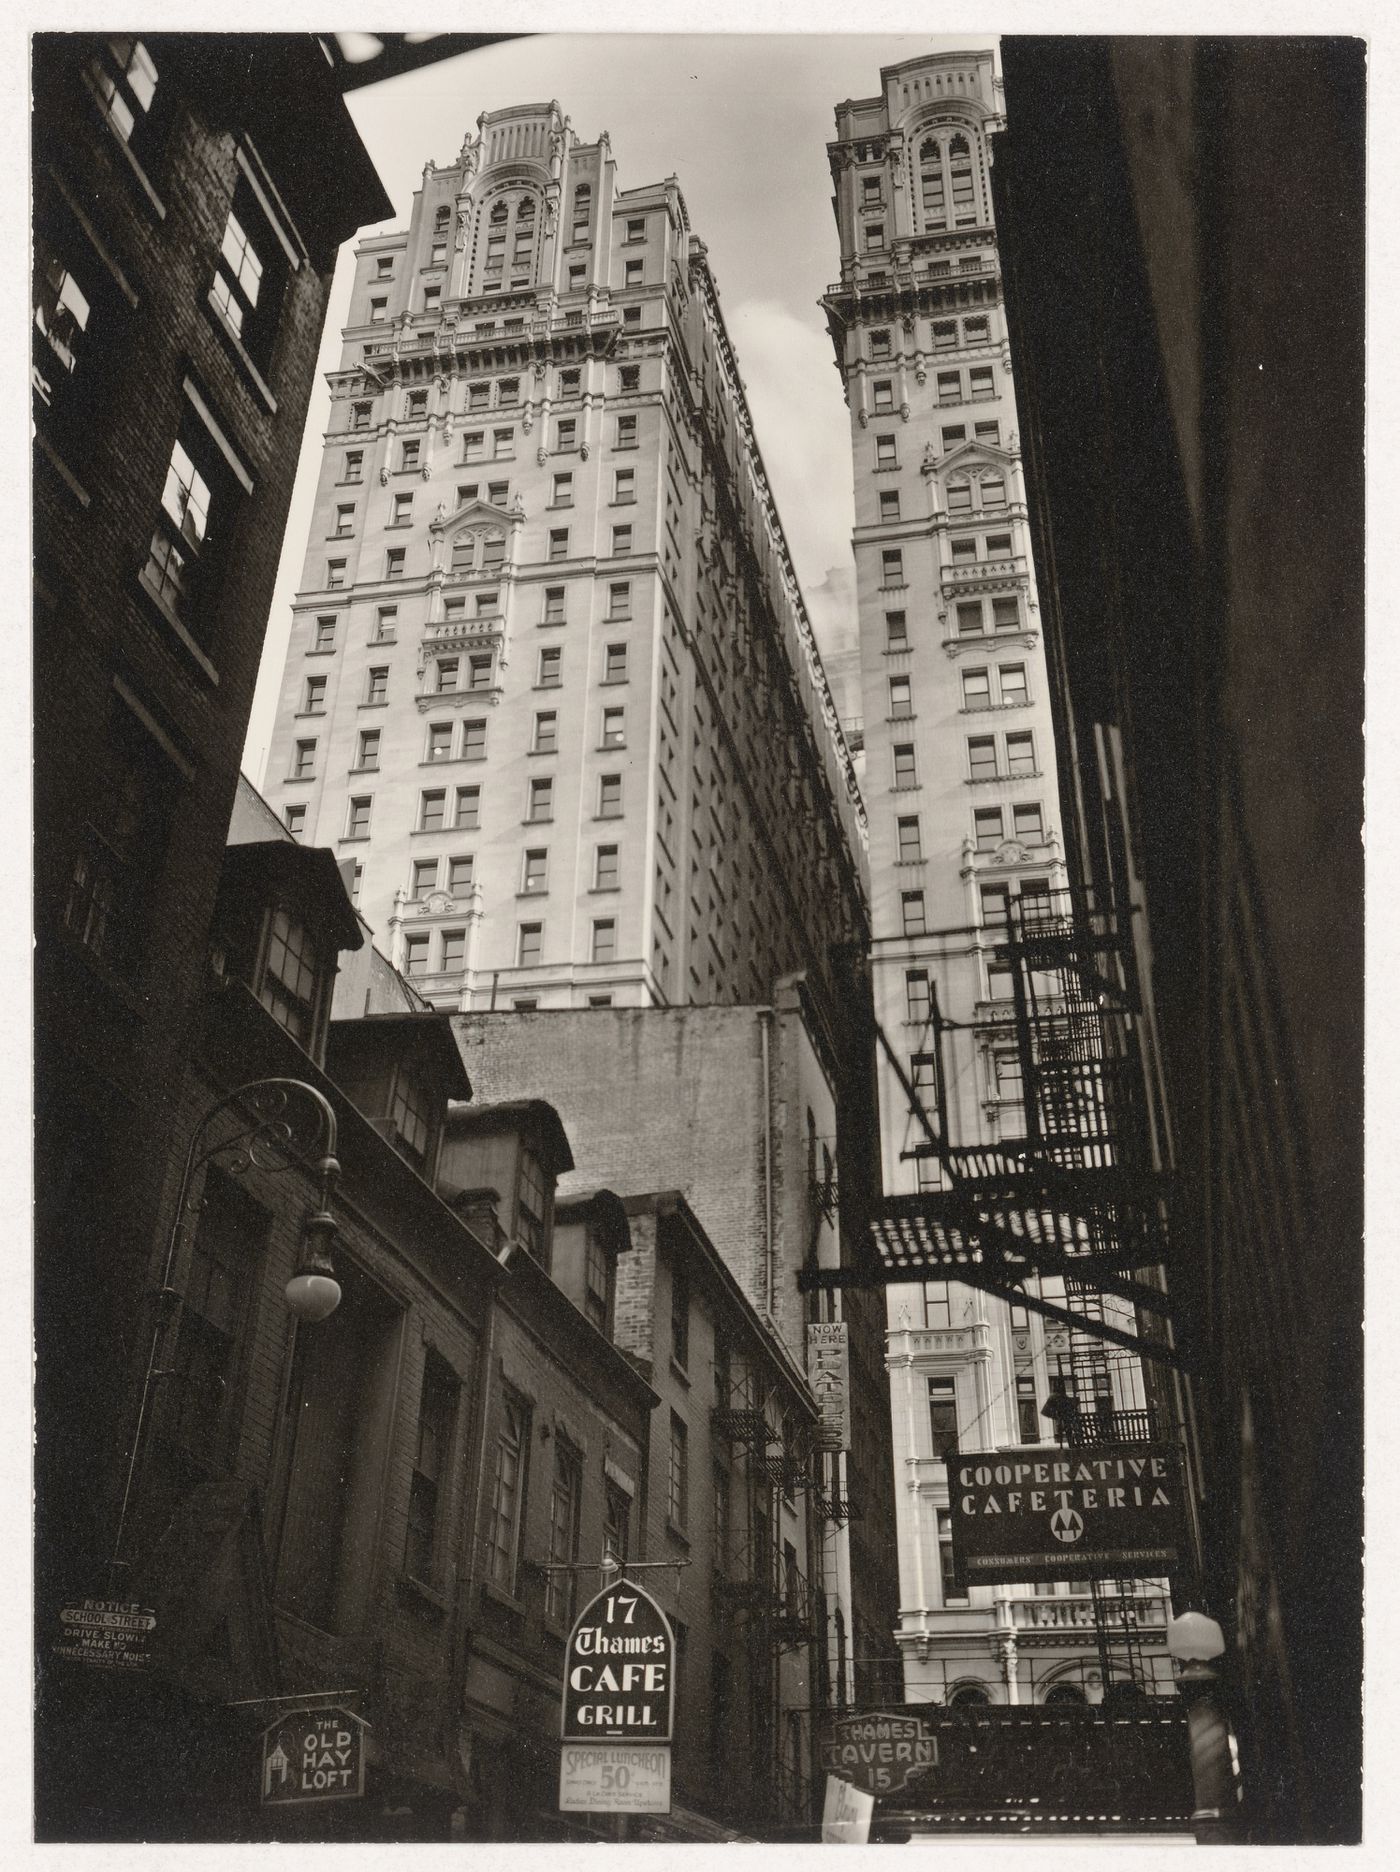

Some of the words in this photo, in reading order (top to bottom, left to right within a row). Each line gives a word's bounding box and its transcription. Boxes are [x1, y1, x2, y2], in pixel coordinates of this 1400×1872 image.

[809, 1335, 846, 1344] HERE
[813, 1325, 842, 1334] NOW
[960, 1458, 1167, 1487] COOPERATIVE
[962, 1486, 1170, 1515] CAFETERIA
[977, 1555, 1031, 1566] CONSUMERS
[1044, 1552, 1110, 1564] COOPERATIVE
[1121, 1549, 1167, 1560] SERVICES
[84, 1599, 140, 1615] NOTICE
[606, 1595, 638, 1624] 17
[65, 1610, 106, 1624] SCHOOL
[111, 1614, 153, 1629] STREET
[64, 1628, 99, 1639] DRIVE
[575, 1626, 665, 1656] Thames
[82, 1639, 110, 1649] MAKE
[114, 1642, 126, 1651] NO
[570, 1664, 667, 1692] CAFE
[316, 1720, 339, 1730] THE
[577, 1705, 657, 1726] GRILL
[304, 1731, 351, 1751] OLD
[841, 1722, 915, 1740] THAMES
[303, 1749, 351, 1769] HAY
[829, 1742, 931, 1764] TAVERN
[566, 1751, 608, 1775] SPECIAL
[611, 1752, 666, 1779] LUNCHEON
[302, 1769, 352, 1789] LOFT
[868, 1768, 891, 1788] 15
